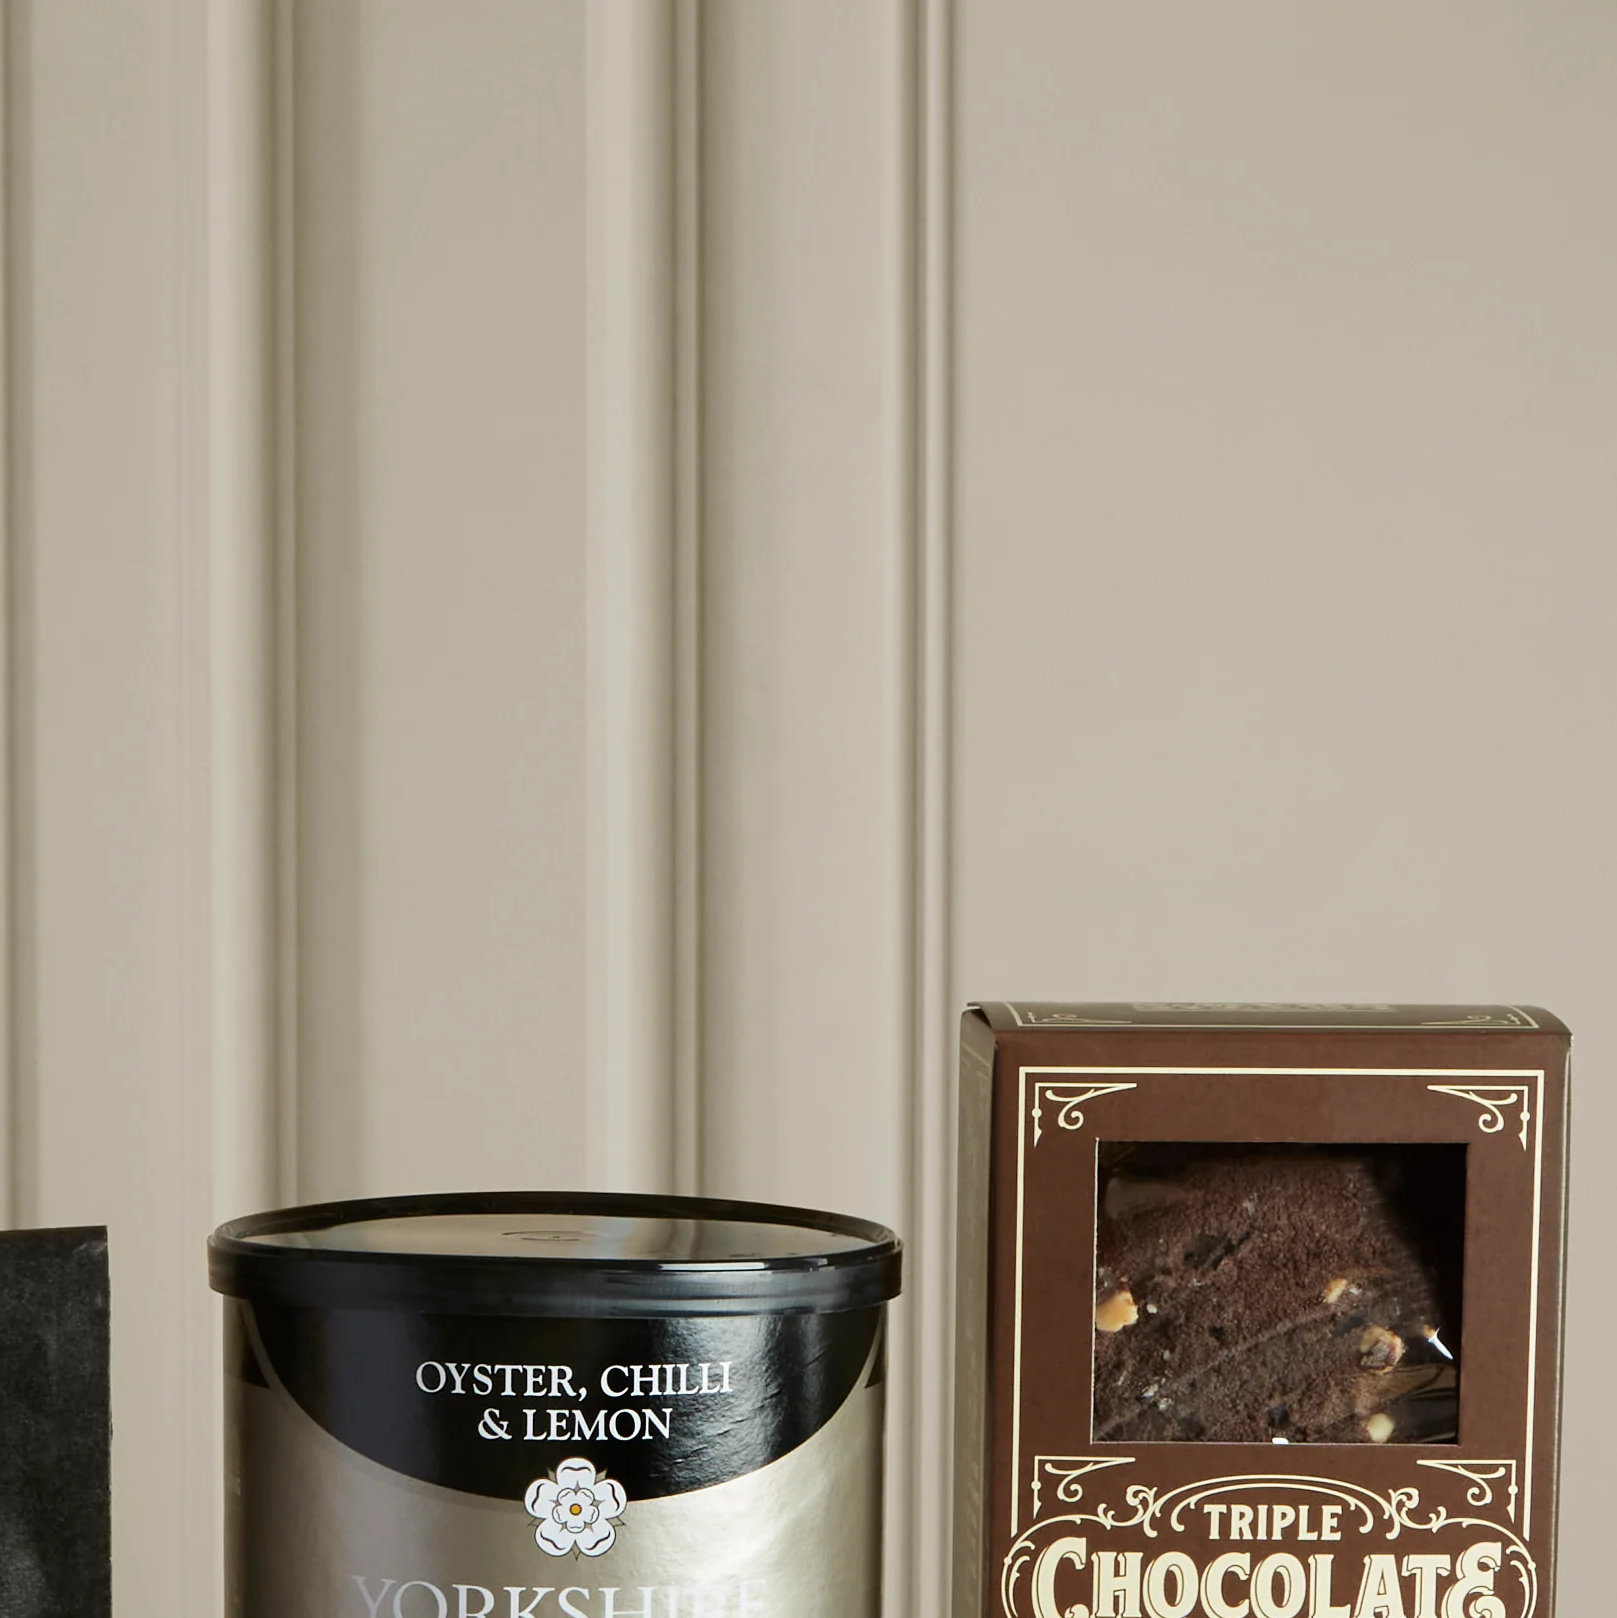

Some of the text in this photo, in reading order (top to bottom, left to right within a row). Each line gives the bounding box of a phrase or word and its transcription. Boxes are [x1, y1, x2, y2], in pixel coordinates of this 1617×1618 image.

[416, 1361, 733, 1400] OYSTER, CHILLI
[477, 1407, 672, 1441] & LEMON
[1203, 1503, 1342, 1540] TRIPLE
